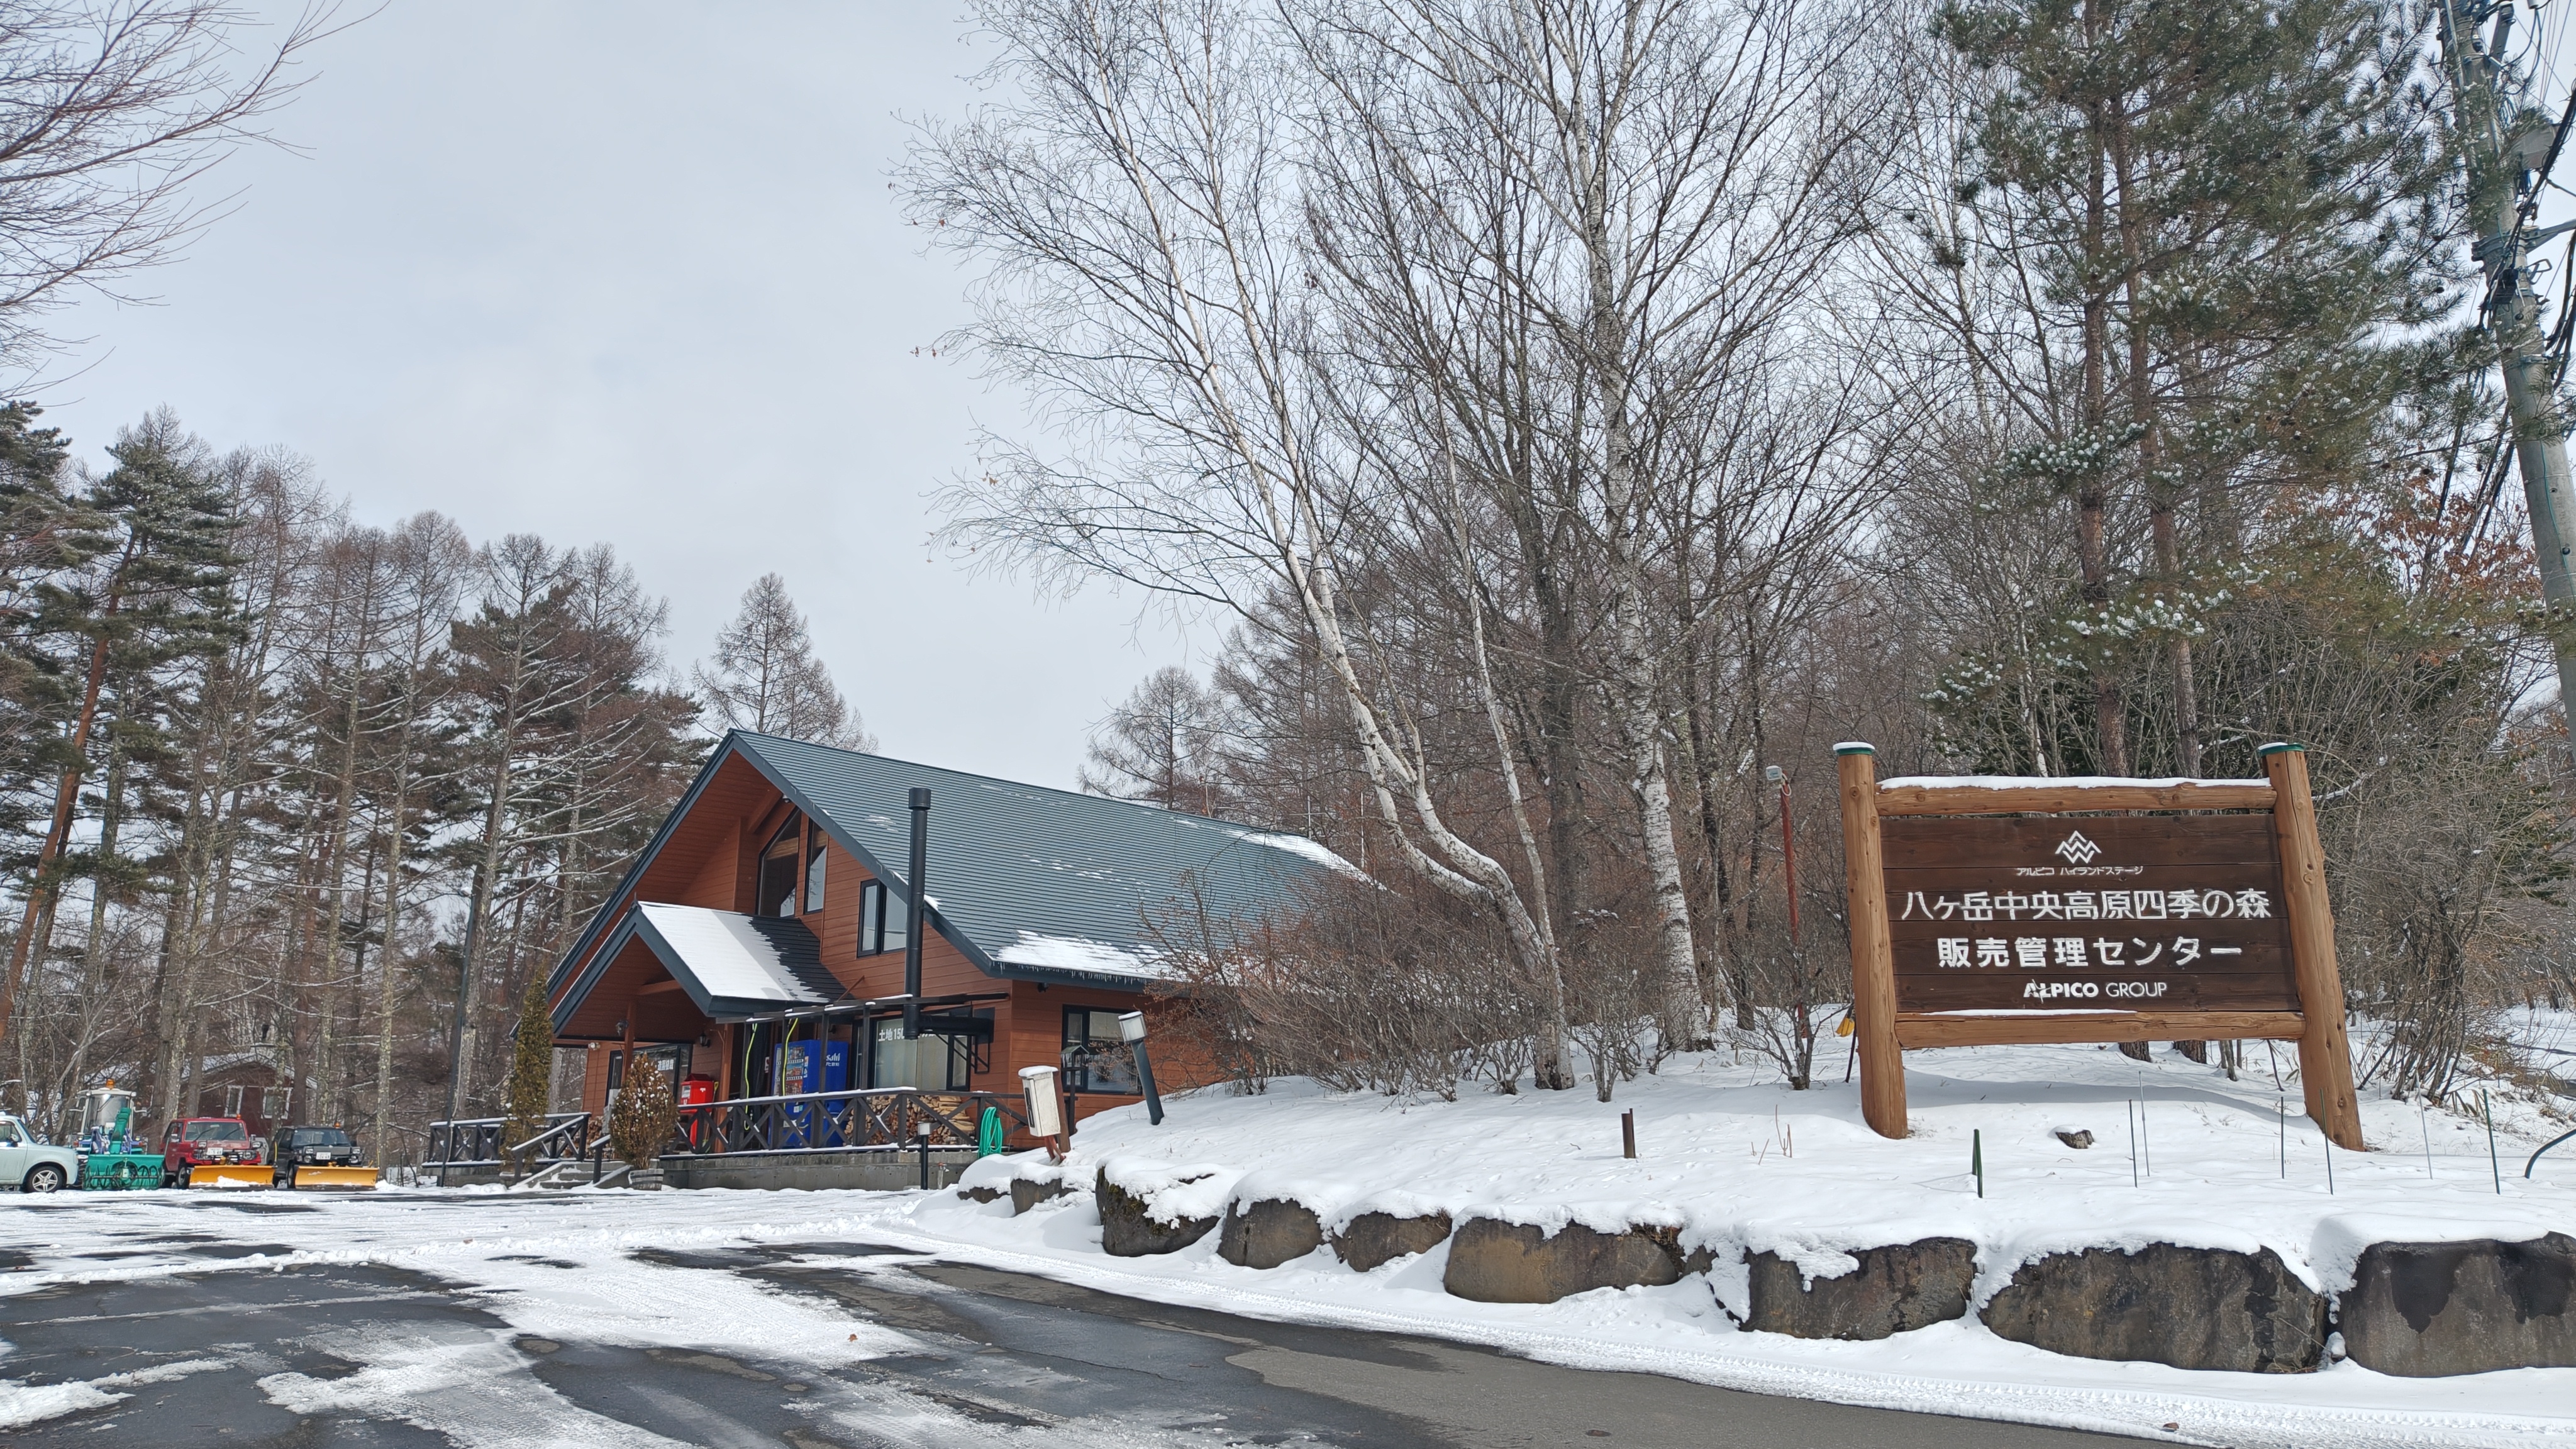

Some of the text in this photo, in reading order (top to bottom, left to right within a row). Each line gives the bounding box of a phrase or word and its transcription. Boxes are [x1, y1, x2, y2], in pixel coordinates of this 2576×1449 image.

[2017, 865, 2144, 876] アルピコ ハイランドステージ
[1937, 936, 2243, 968] 販売管理センター
[2023, 979, 2168, 1002] ALPICO GROUP
